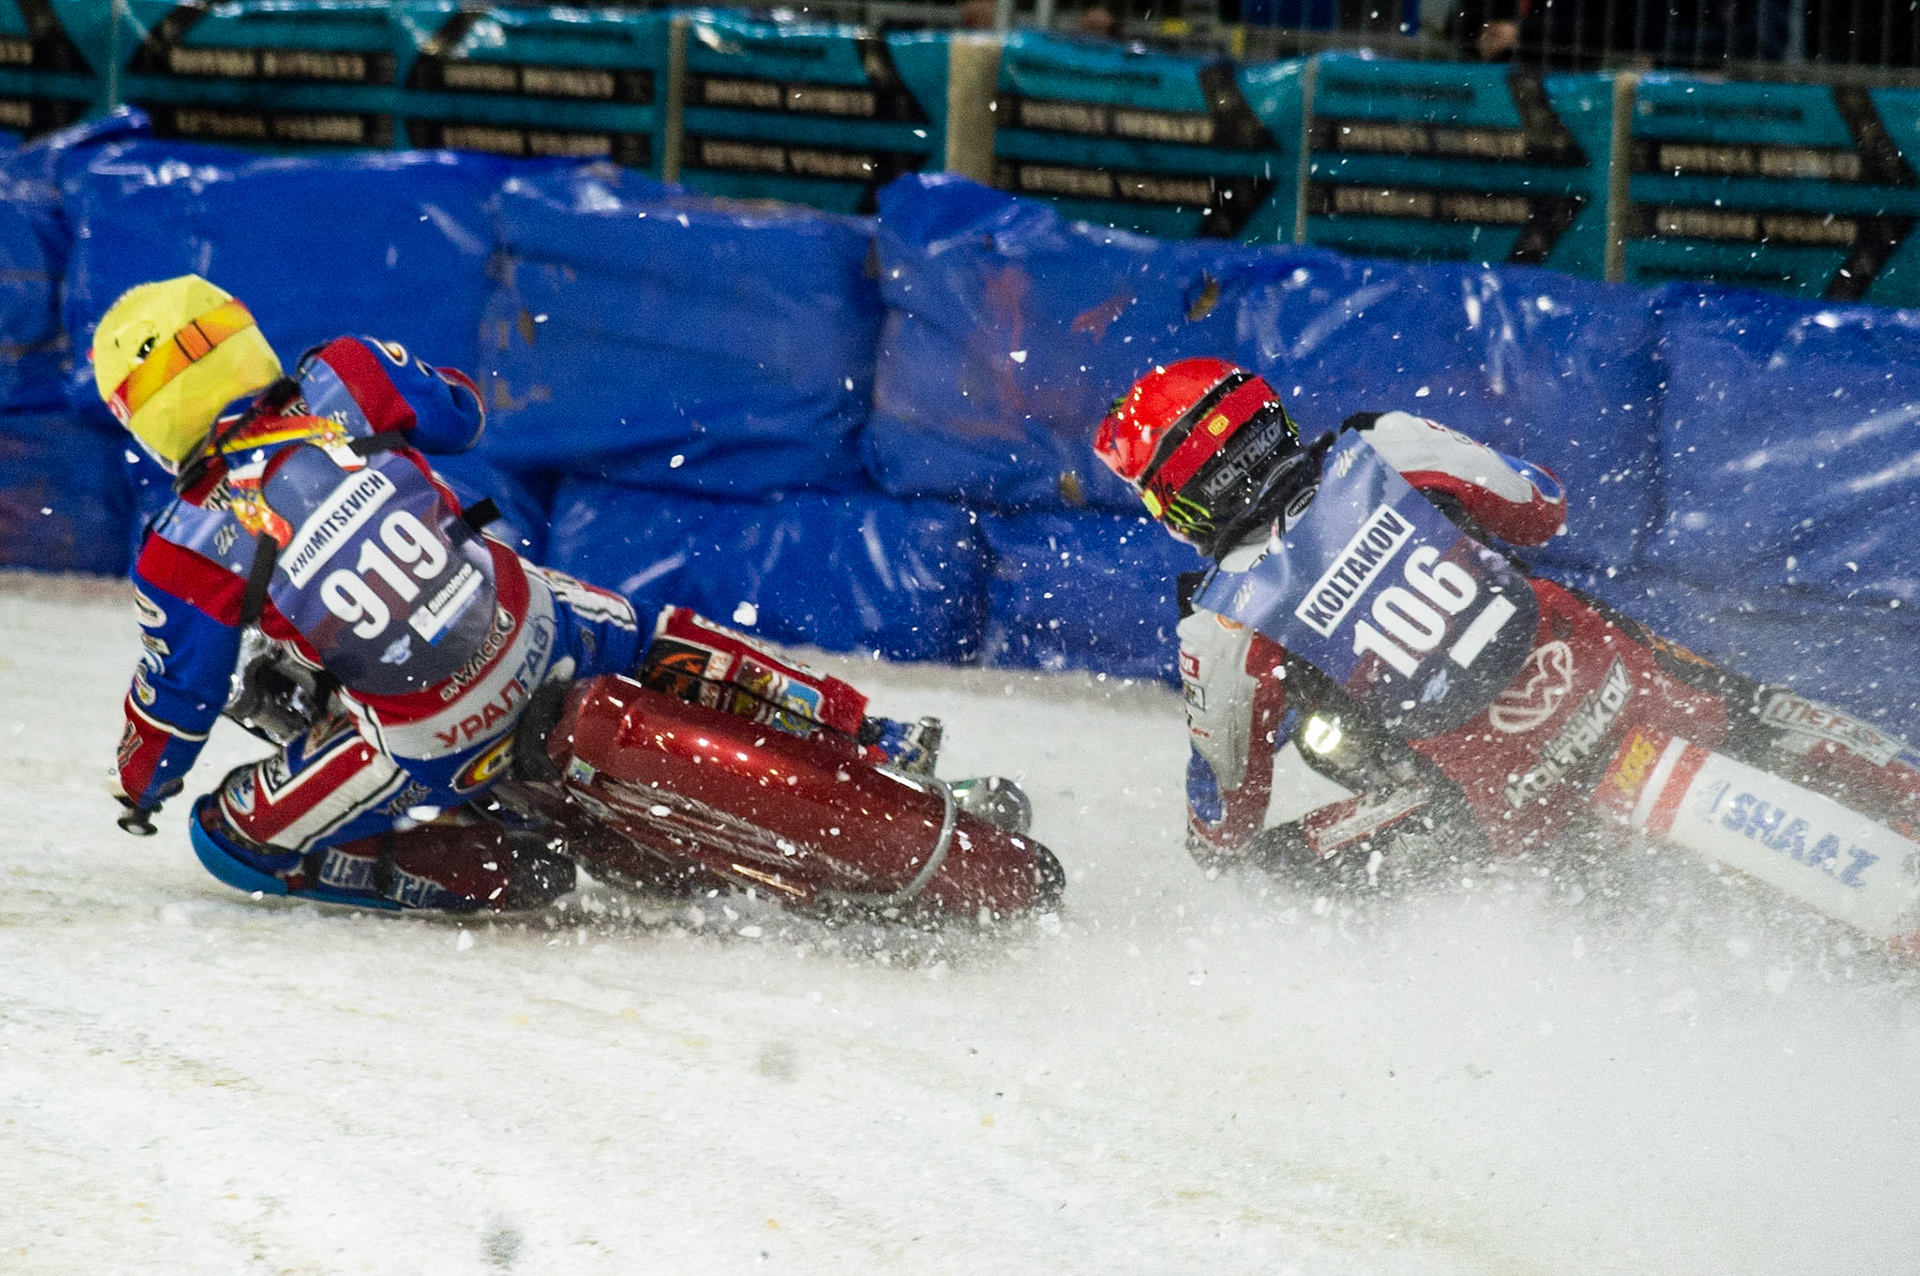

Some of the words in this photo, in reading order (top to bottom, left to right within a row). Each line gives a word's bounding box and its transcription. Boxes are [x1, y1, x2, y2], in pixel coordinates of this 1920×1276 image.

[320, 510, 448, 640] 919
[1305, 511, 1406, 629] KOLTAKOV
[1353, 545, 1477, 679] 106
[1720, 792, 1880, 890] SHAAZ
